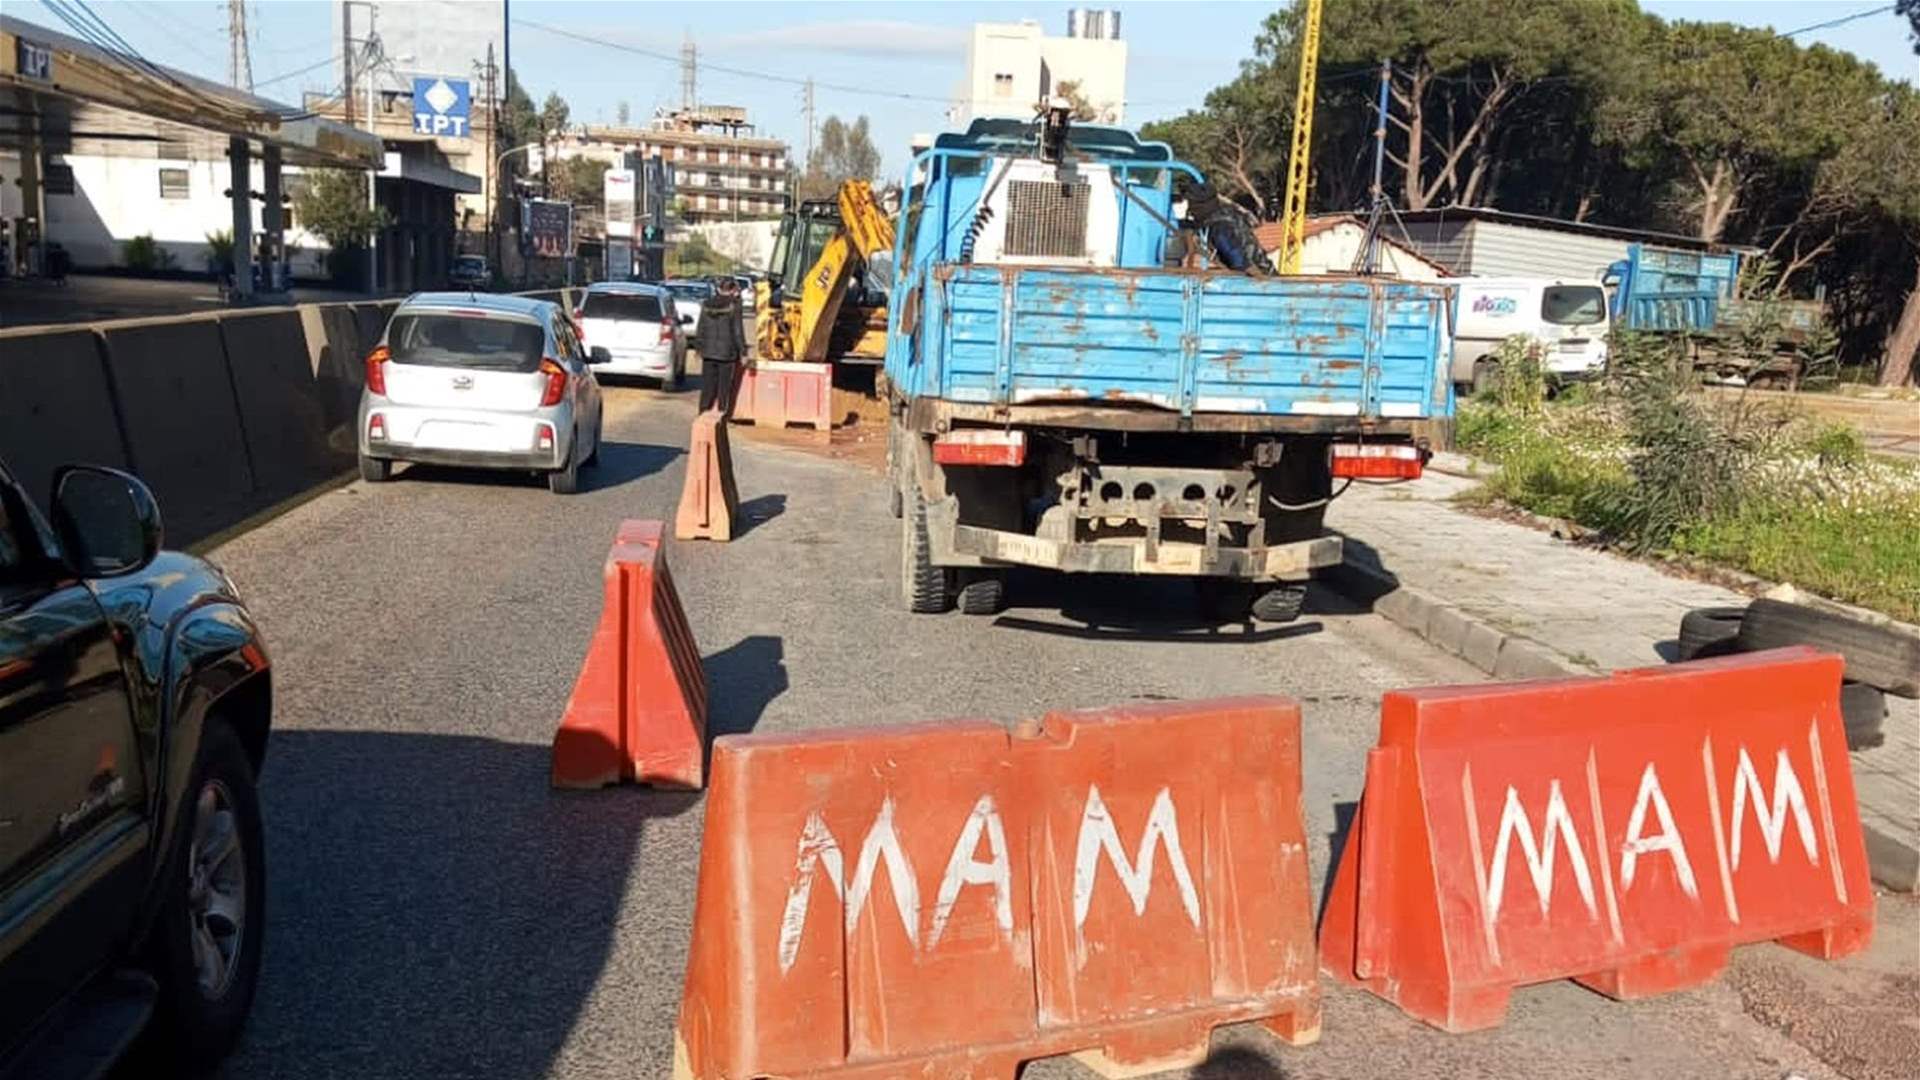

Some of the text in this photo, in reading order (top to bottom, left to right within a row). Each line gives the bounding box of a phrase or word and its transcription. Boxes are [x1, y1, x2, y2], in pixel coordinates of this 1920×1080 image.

[415, 113, 467, 136] IPT
[778, 783, 1201, 977] MAM
[1486, 746, 1819, 923] MAM
